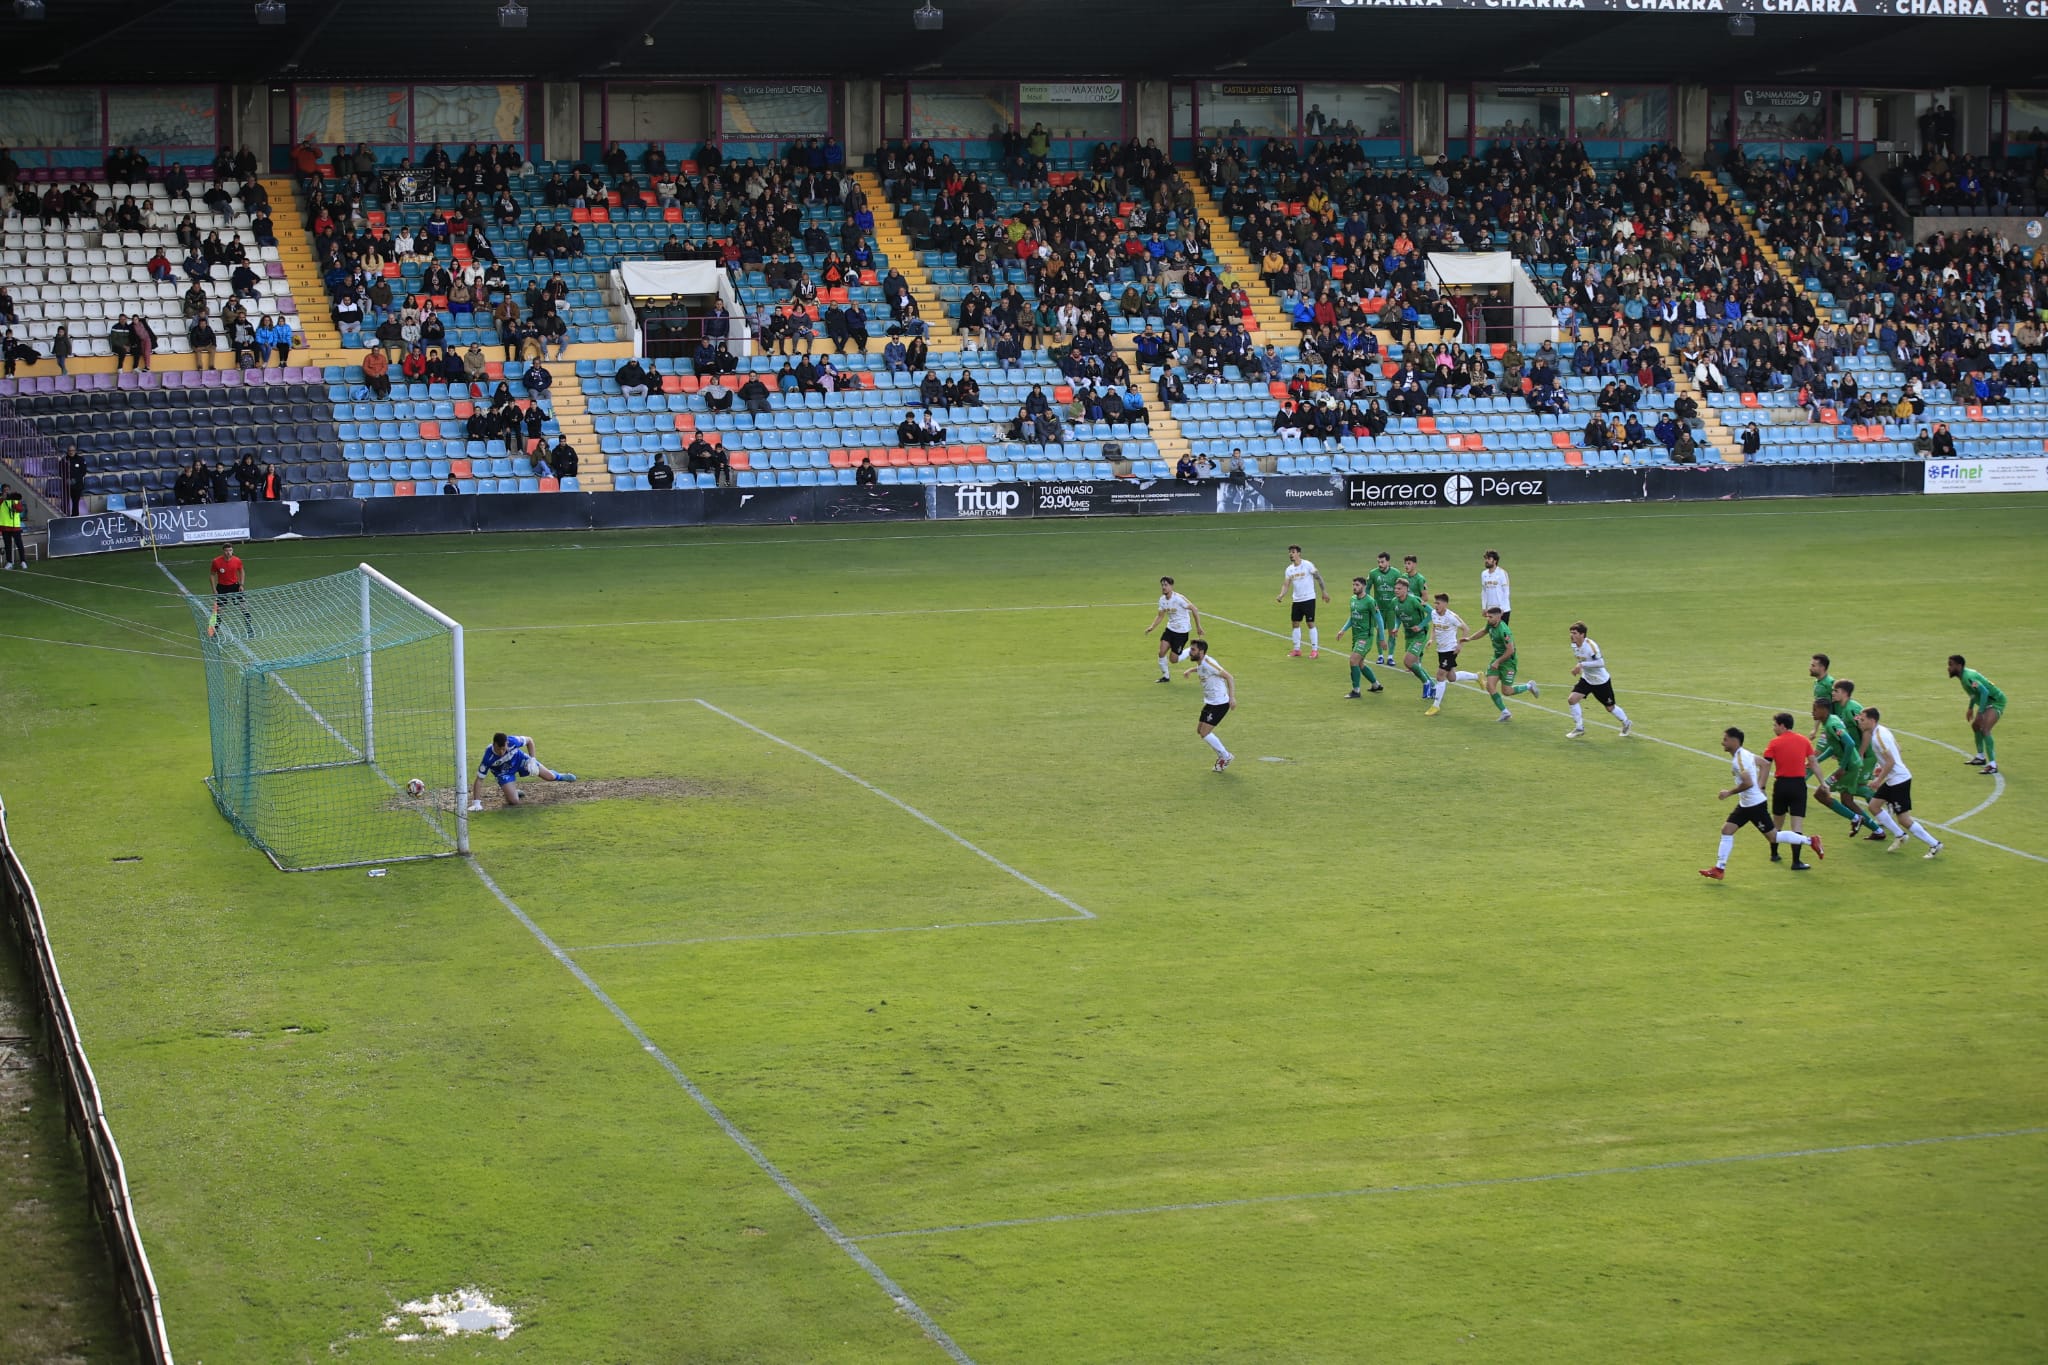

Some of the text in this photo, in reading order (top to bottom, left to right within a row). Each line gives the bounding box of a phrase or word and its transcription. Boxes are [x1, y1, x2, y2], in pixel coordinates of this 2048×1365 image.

[1626, 0, 1724, 10] CHARRA
[1762, 0, 1858, 12] CHARRA
[1895, 0, 1989, 15] CHARRA
[1941, 464, 1983, 479] Frinet
[1039, 485, 1094, 495] TU GIMNASIO
[1285, 487, 1334, 498] fitupweb.es
[1350, 477, 1543, 500] Herrero Pérez
[955, 484, 1020, 515] fitup
[958, 509, 1001, 517] SMART GYM
